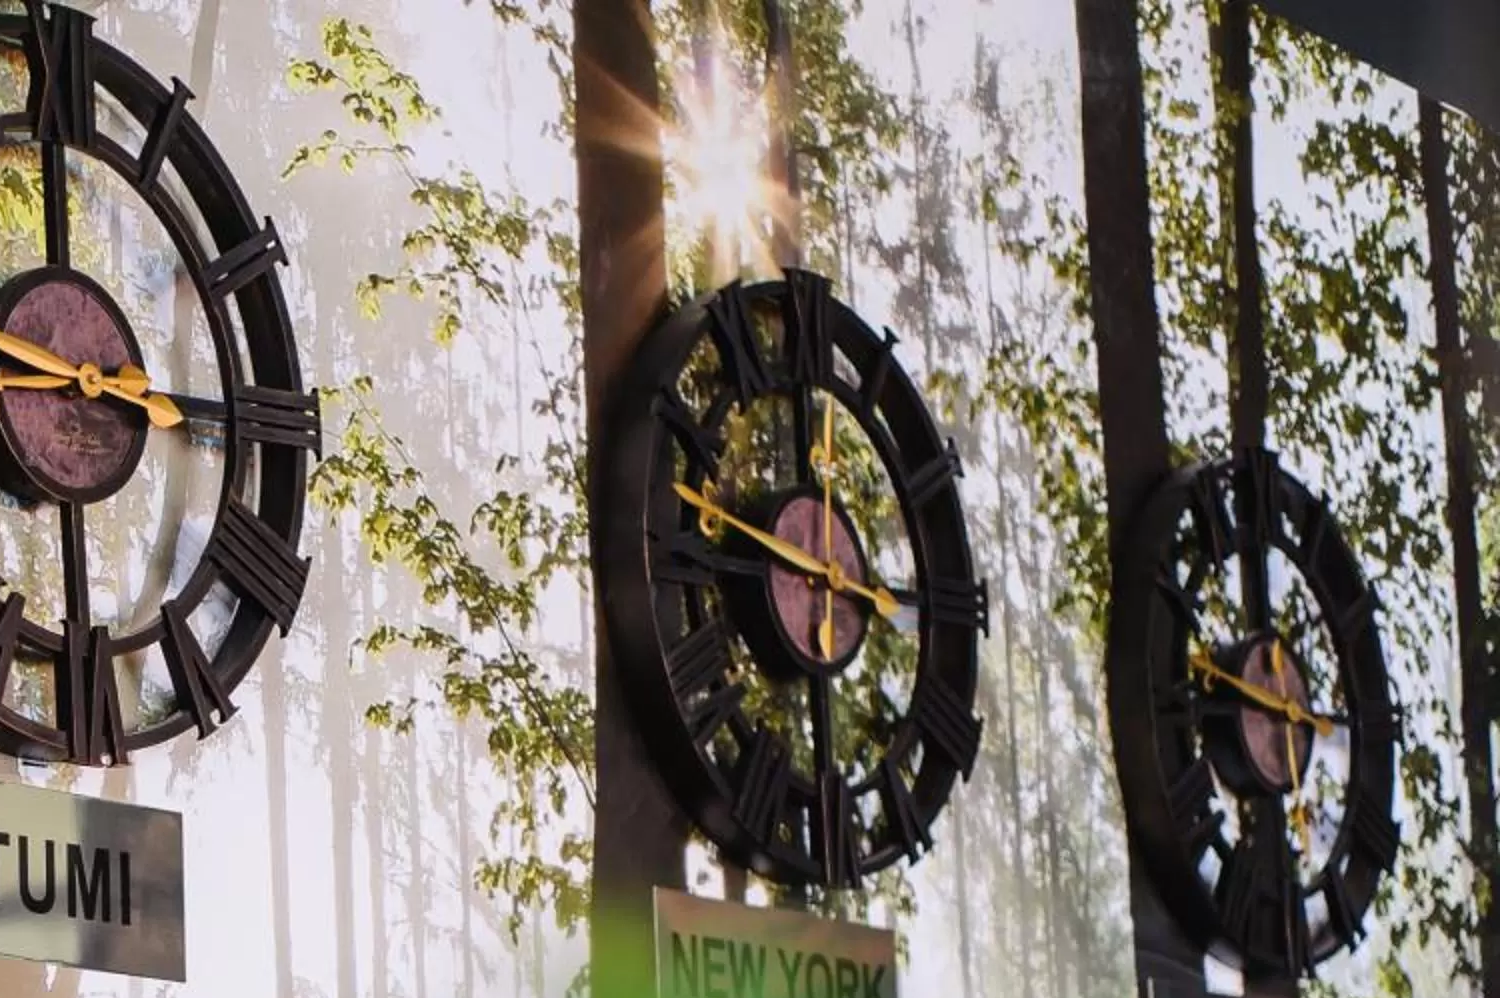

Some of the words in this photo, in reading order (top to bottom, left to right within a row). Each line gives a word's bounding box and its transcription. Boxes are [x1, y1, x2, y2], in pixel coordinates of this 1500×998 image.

[200, 215, 290, 300] II
[234, 386, 323, 461] III
[160, 600, 240, 741] V
